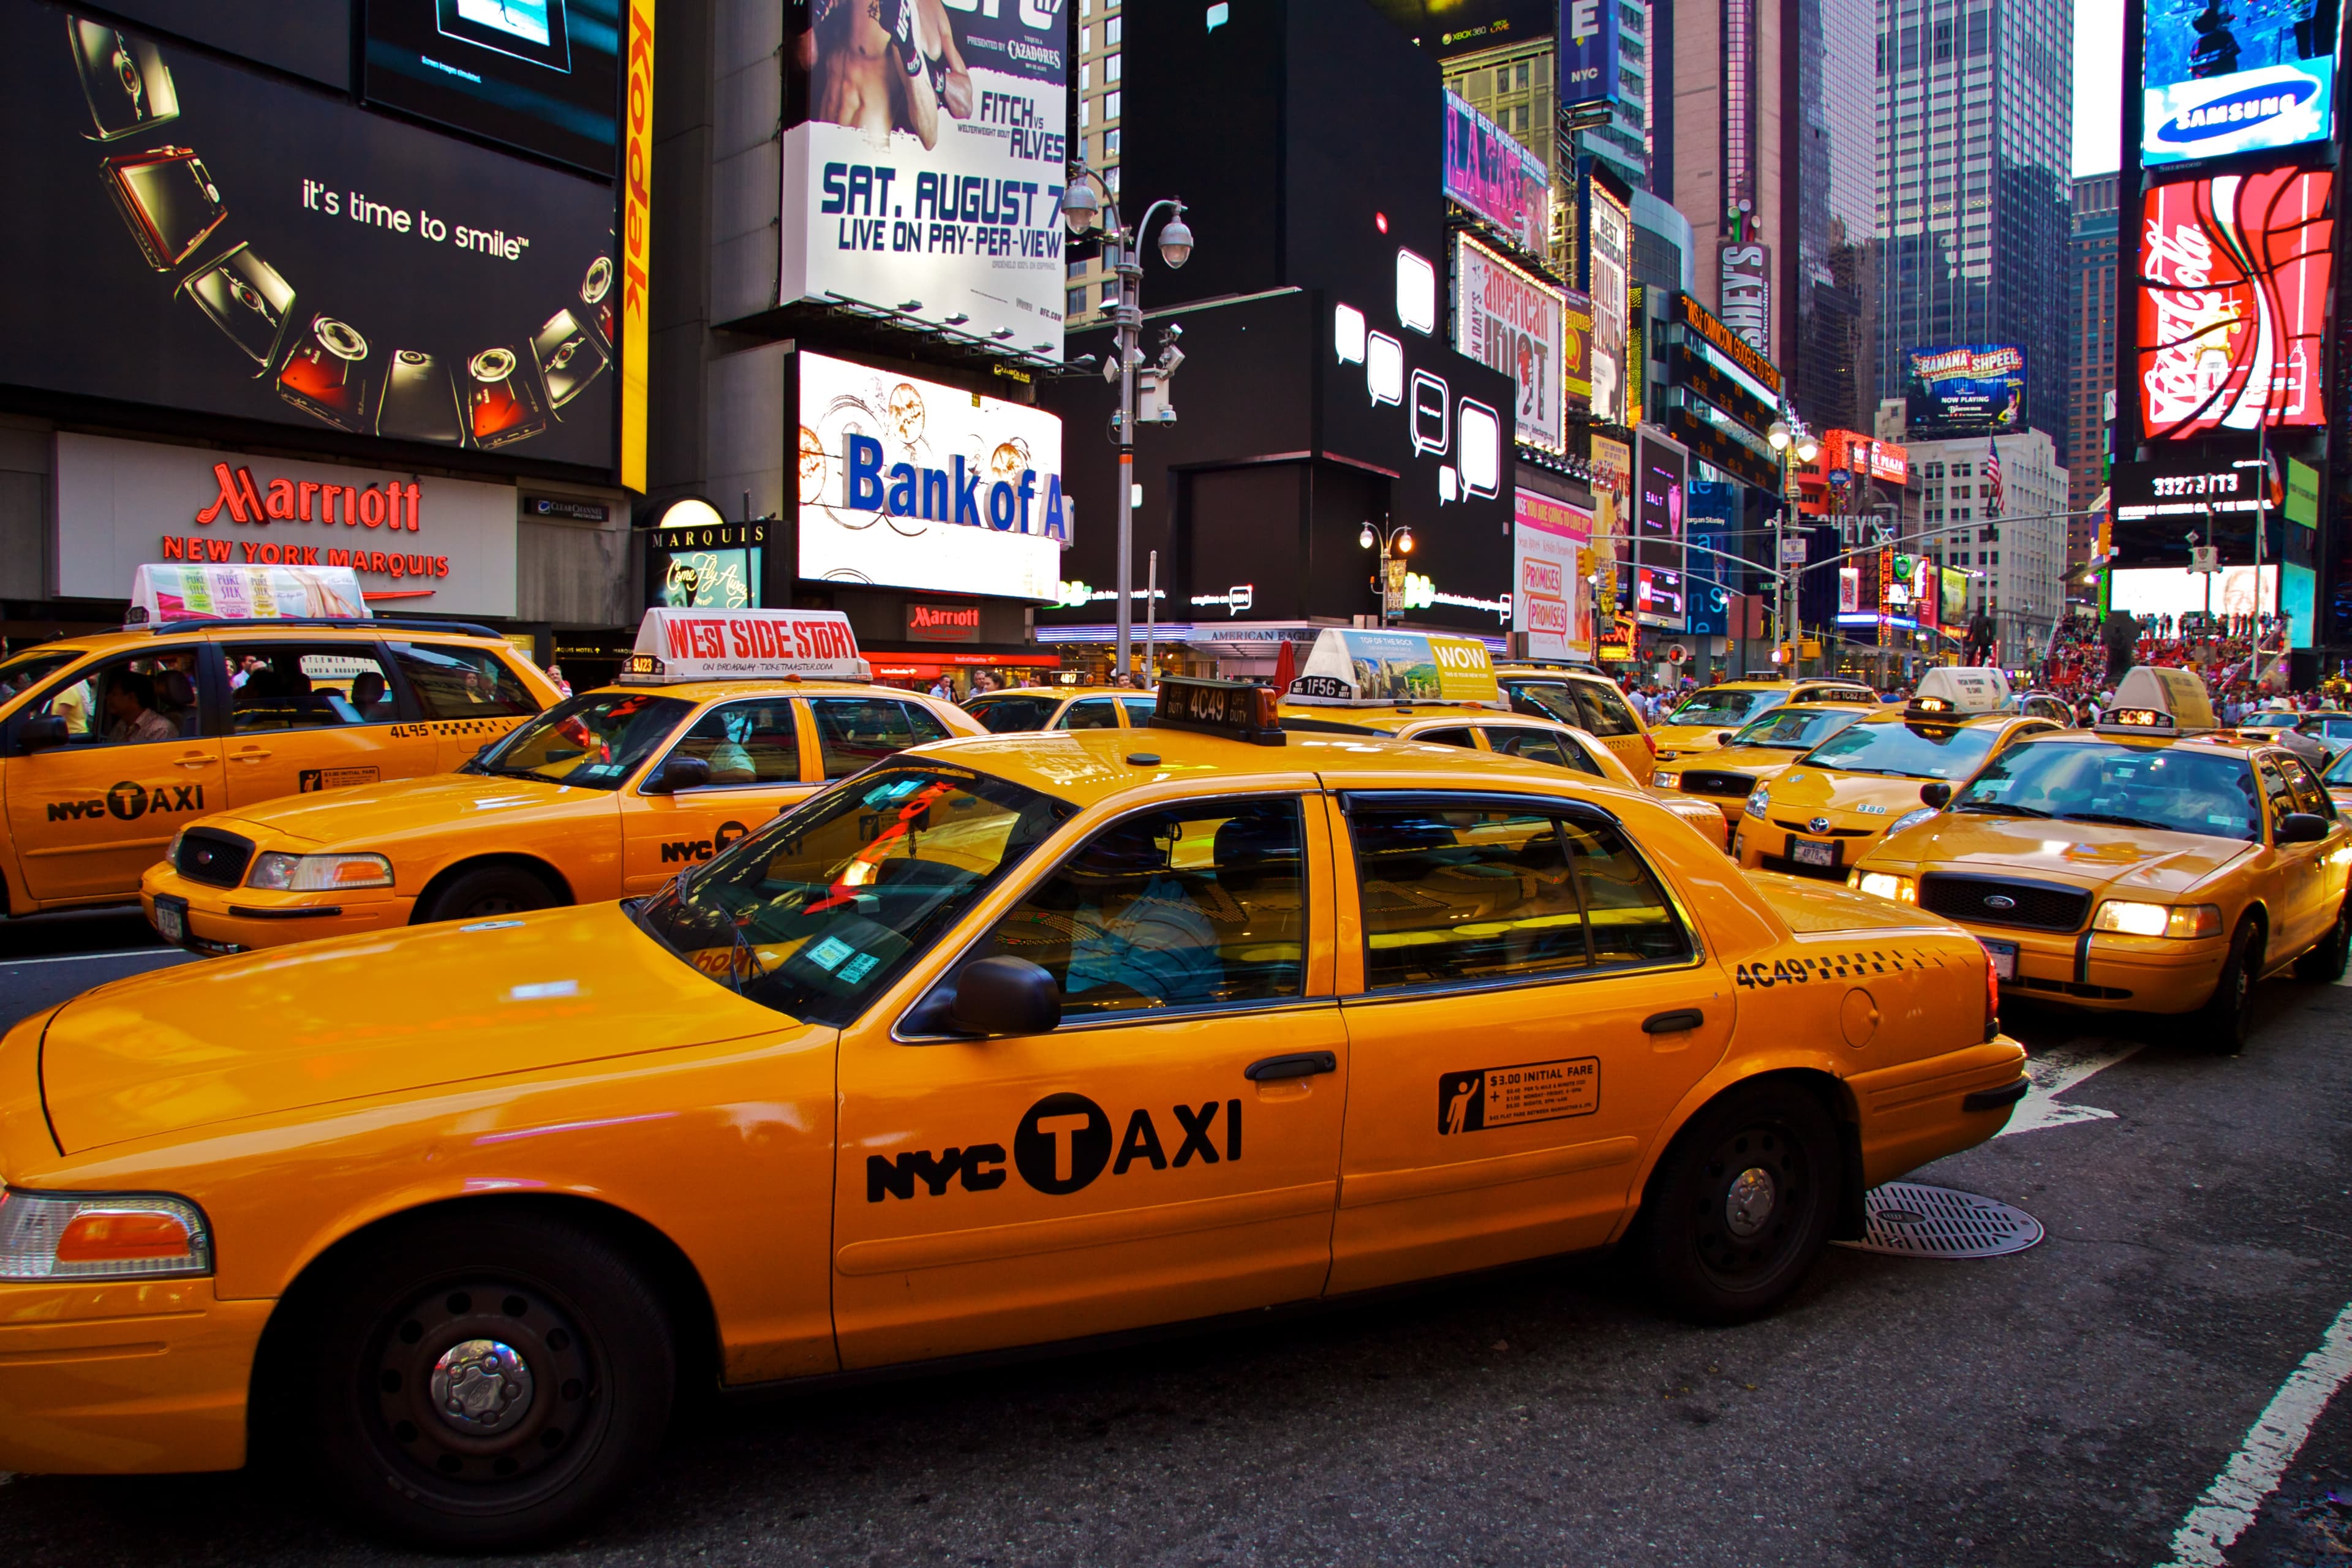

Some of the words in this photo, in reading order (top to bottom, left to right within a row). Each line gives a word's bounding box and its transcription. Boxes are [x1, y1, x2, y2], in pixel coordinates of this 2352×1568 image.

[1452, 29, 1472, 41] XBOX
[1472, 26, 1487, 36] 360
[1490, 23, 1509, 33] LIVE
[1008, 40, 1060, 69] CAZADORES
[1572, 67, 1598, 83] NYC
[981, 90, 1034, 129] FITCH
[1034, 116, 1044, 129] VS
[2176, 92, 2297, 130] SAMSUNG
[997, 129, 1010, 138] BOUT
[1446, 89, 1476, 123] WINNER!
[1477, 112, 1495, 138] BEST
[1496, 126, 1522, 159] MUSICAL
[1010, 127, 1065, 164] ALVES
[1447, 105, 1480, 198] LA
[626, 4, 652, 320] Kodak
[2158, 160, 2202, 172] SHERWOOD
[821, 162, 902, 217] SAT.
[914, 172, 1038, 227] AUGUST
[1047, 184, 1065, 228] 7
[303, 179, 340, 215] it's
[350, 191, 412, 233] time
[420, 210, 447, 242] to
[839, 218, 886, 251] LIVE
[893, 221, 922, 252] ON
[929, 223, 1062, 258] PAY-PER-VIEW
[1600, 214, 1618, 244] BEST
[1593, 228, 1625, 271] MUSICAL
[1484, 264, 1548, 341] american
[1722, 245, 1763, 352] SHEY'S
[1039, 307, 1063, 322] UFC.COM
[1566, 309, 1591, 333] enue
[1566, 326, 1582, 375] Q
[1921, 352, 1968, 373] BANANA
[1972, 351, 2019, 372] SHPEEL
[843, 433, 981, 527] Bank
[984, 469, 1036, 532] of
[196, 461, 421, 531] Marriott
[1646, 491, 1663, 507] SALT
[1705, 516, 1725, 526] Stanley
[652, 526, 764, 548] MARQUIS
[163, 536, 233, 562] NEW
[241, 541, 320, 565] YORK
[328, 549, 450, 578] MARQUIS
[186, 575, 205, 584] PURE
[217, 574, 240, 585] PURE
[250, 578, 268, 586] PURE
[666, 558, 699, 592] Come
[692, 552, 718, 593] Fly
[1525, 564, 1559, 592] PROMISES
[190, 585, 210, 597] SILK
[221, 587, 245, 600] SILK
[254, 586, 273, 597] SILK
[910, 606, 979, 627] Marriott
[1531, 601, 1565, 629] PROMISES
[665, 619, 726, 659] WEST
[728, 619, 794, 659] SIDE
[793, 620, 858, 660] STORY
[1212, 631, 1275, 641] AMERICAN
[1278, 631, 1316, 641] EAGLE
[1359, 636, 1374, 645] TOP
[1396, 638, 1414, 647] ROCK
[633, 657, 653, 673] 9J23
[703, 663, 715, 671] ON
[716, 663, 756, 672] BROADWAY
[1433, 646, 1485, 669] WOW
[1307, 679, 1336, 697] 1F56
[1190, 687, 1225, 722] 4C49
[2119, 709, 2154, 725] 5C96
[390, 725, 429, 739] 4L95
[47, 799, 105, 822] NYC
[107, 781, 204, 821] TAXI
[1858, 804, 1885, 814] 380
[662, 840, 712, 862] NYC
[1735, 958, 1807, 989] 4C49
[1490, 1073, 1520, 1087] $3.00
[1524, 1068, 1562, 1082] INITIAL
[1567, 1065, 1593, 1077] FARE
[866, 1143, 1006, 1203] NYC
[1014, 1092, 1242, 1196] TAXI
